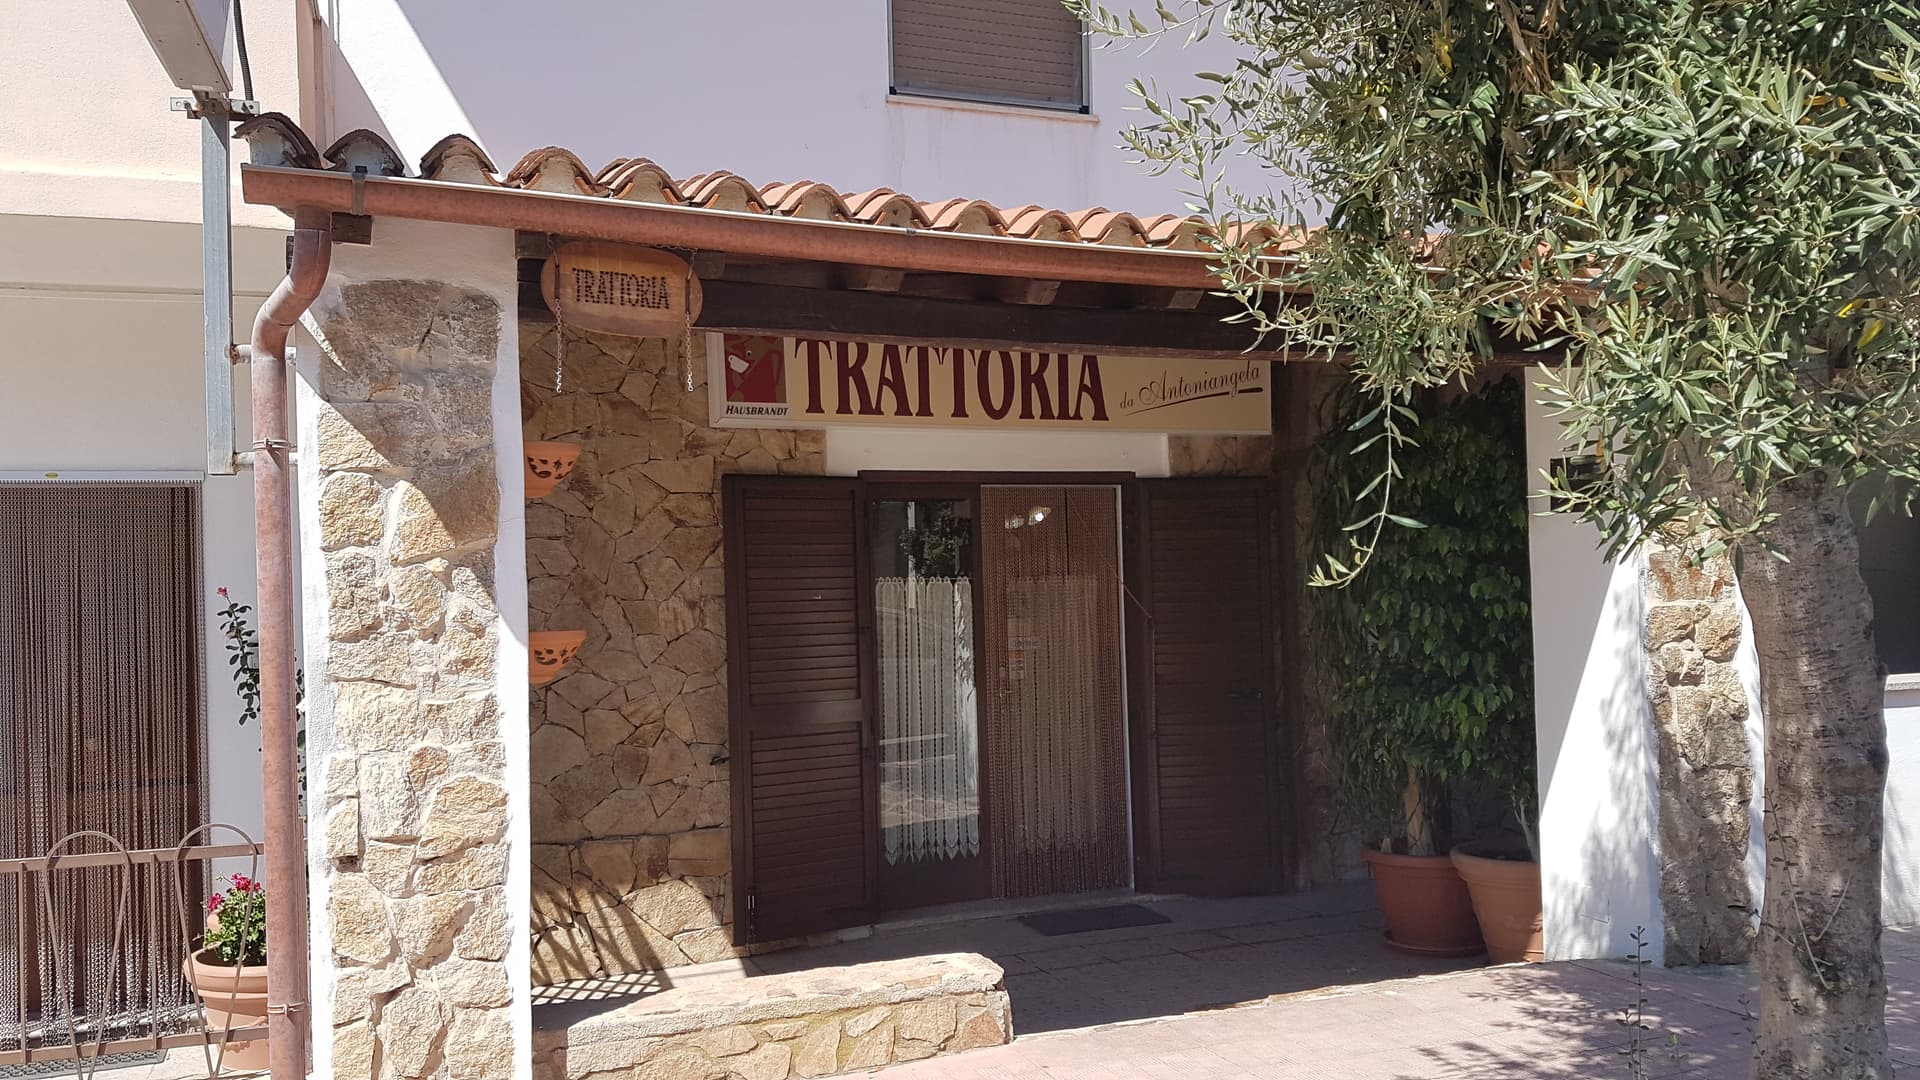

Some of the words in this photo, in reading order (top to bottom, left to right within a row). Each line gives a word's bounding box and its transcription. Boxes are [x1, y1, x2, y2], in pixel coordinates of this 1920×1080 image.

[572, 267, 669, 309] TRATTORIA
[794, 337, 1110, 421] TRATTORIA
[1120, 391, 1135, 409] da
[1138, 360, 1262, 398] Antoniangela
[726, 405, 789, 416] HAUSBRANDT
